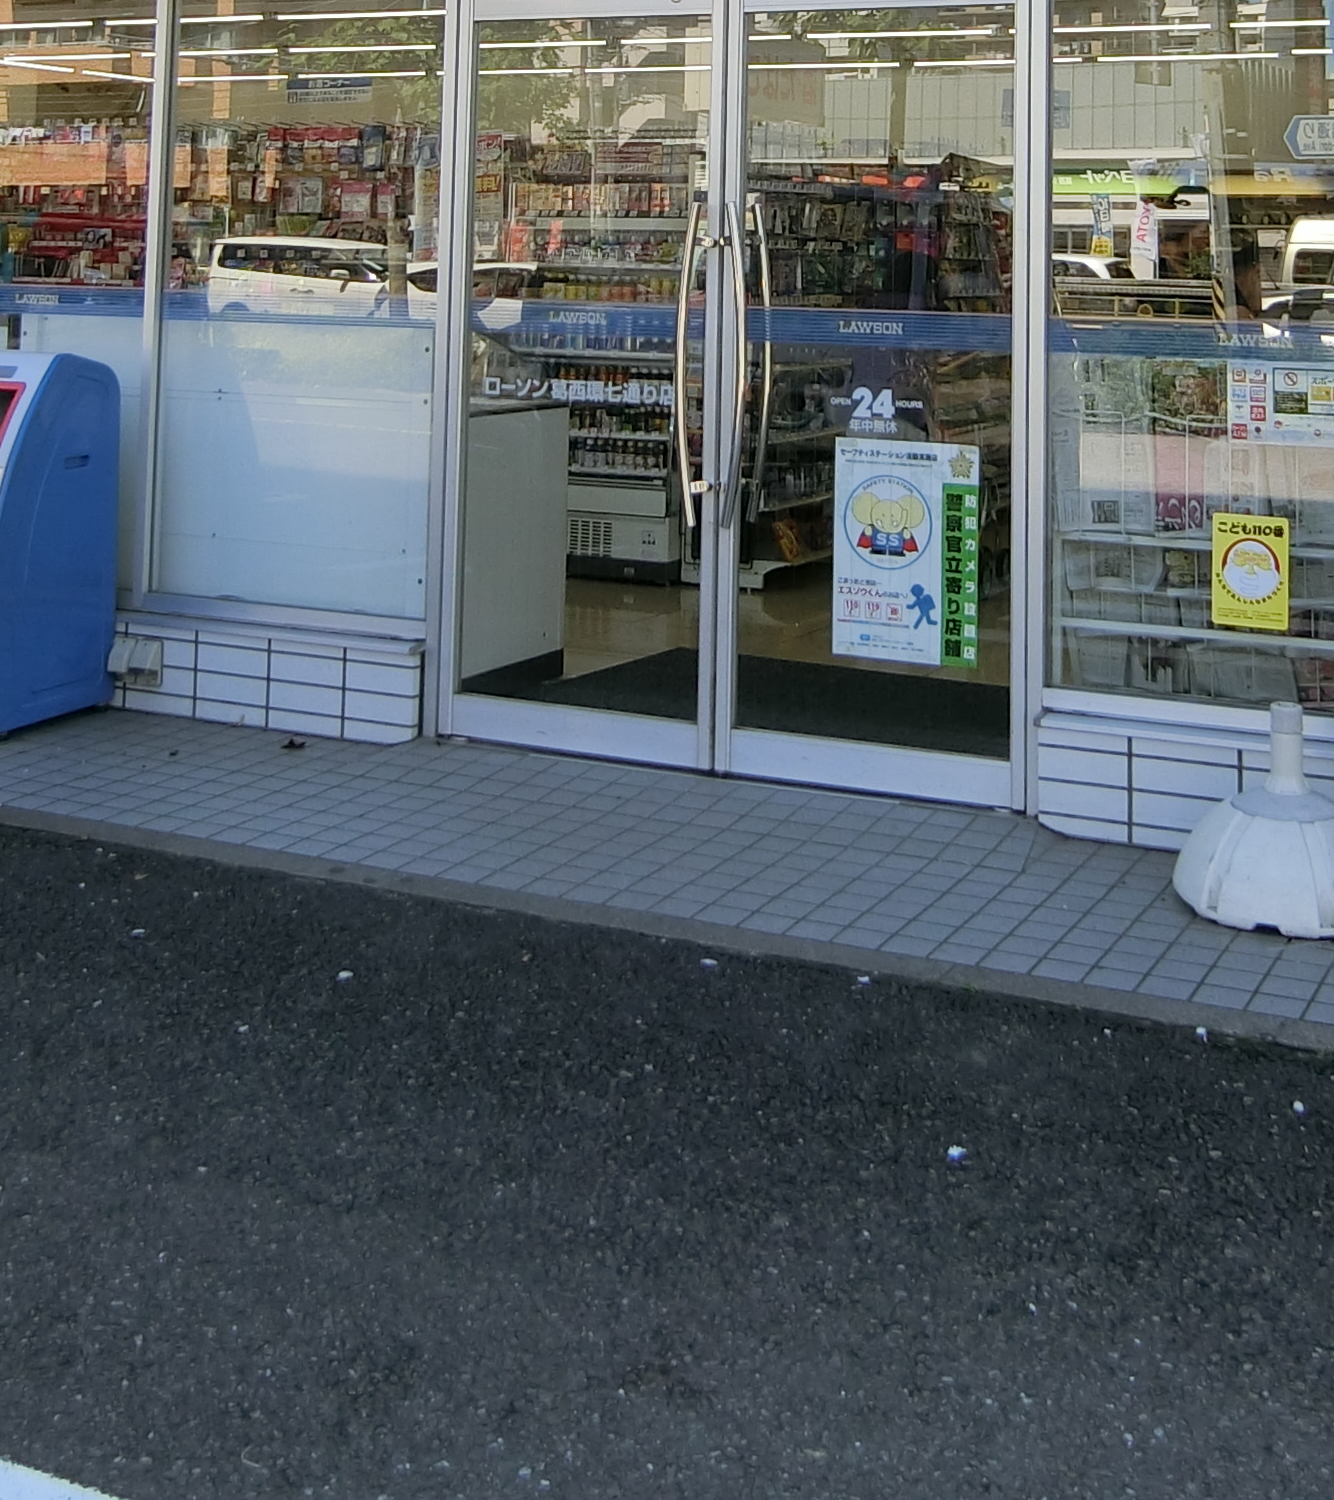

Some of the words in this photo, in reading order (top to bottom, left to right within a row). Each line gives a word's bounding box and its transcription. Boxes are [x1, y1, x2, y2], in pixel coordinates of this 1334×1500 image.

[549, 311, 607, 326] LAWSON
[838, 320, 904, 336] LAWSON
[483, 376, 675, 407] ローソン葛西環七通り店
[830, 395, 852, 407] OPEN
[851, 385, 896, 419] 24
[896, 400, 924, 410] HOURS
[848, 418, 898, 435] 年中無休
[1217, 521, 1285, 538] こども110番
[876, 533, 900, 545] SS
[945, 492, 963, 658] 警察官立寄り店舗
